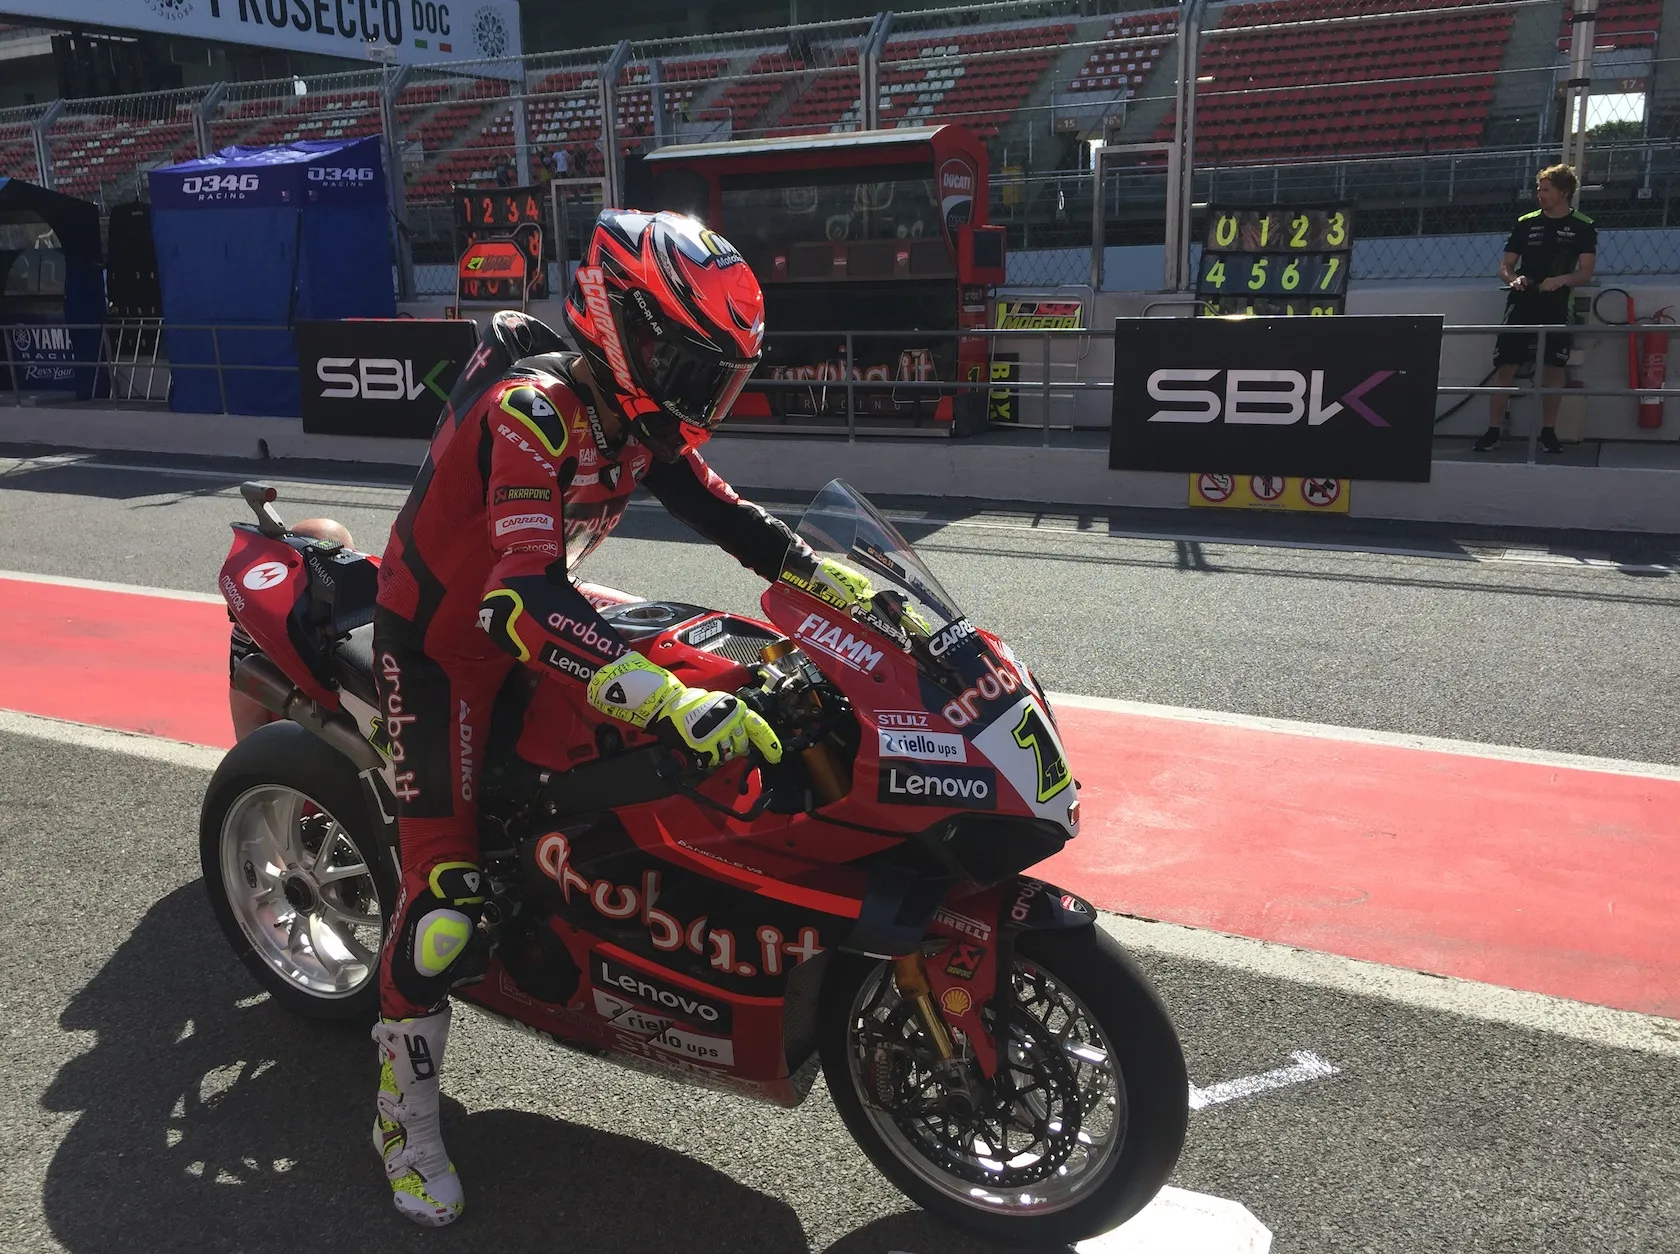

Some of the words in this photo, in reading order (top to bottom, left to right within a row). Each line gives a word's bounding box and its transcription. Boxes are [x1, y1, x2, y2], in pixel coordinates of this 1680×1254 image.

[411, 2, 450, 36] DOC
[1063, 119, 1076, 128] 15
[198, 192, 246, 201] RACING
[943, 173, 971, 190] DUCATI
[464, 197, 472, 223] 1
[482, 197, 495, 223] 2
[506, 196, 519, 223] 3
[526, 194, 539, 221] 4
[1216, 214, 1238, 247] 0
[1258, 215, 1270, 247] 1
[1289, 214, 1310, 248] 2
[1326, 211, 1346, 246] 3
[1205, 260, 1227, 289] 4
[1247, 258, 1269, 290] 5
[1281, 257, 1301, 290] 6
[1319, 257, 1340, 290] 7
[577, 268, 632, 391] SCORPION
[649, 319, 663, 336] AIR
[316, 357, 450, 401] SBK
[1146, 367, 1397, 428] SBK
[804, 399, 901, 411] RACING
[586, 405, 608, 449] DUCATI
[502, 516, 548, 528] CARRERA
[308, 556, 336, 588] DAMAST
[221, 574, 247, 613] motorola
[797, 612, 885, 672] FIAMM
[381, 653, 421, 802] aruba.it
[459, 723, 473, 802] DAIKO
[898, 735, 936, 754] riello
[937, 743, 958, 758] ups
[1010, 703, 1073, 804] 1
[889, 768, 989, 799] Lenovo
[1011, 880, 1045, 921] arub
[602, 961, 719, 1022] Lenovo
[628, 1014, 682, 1049] riello
[686, 1043, 719, 1058] ups
